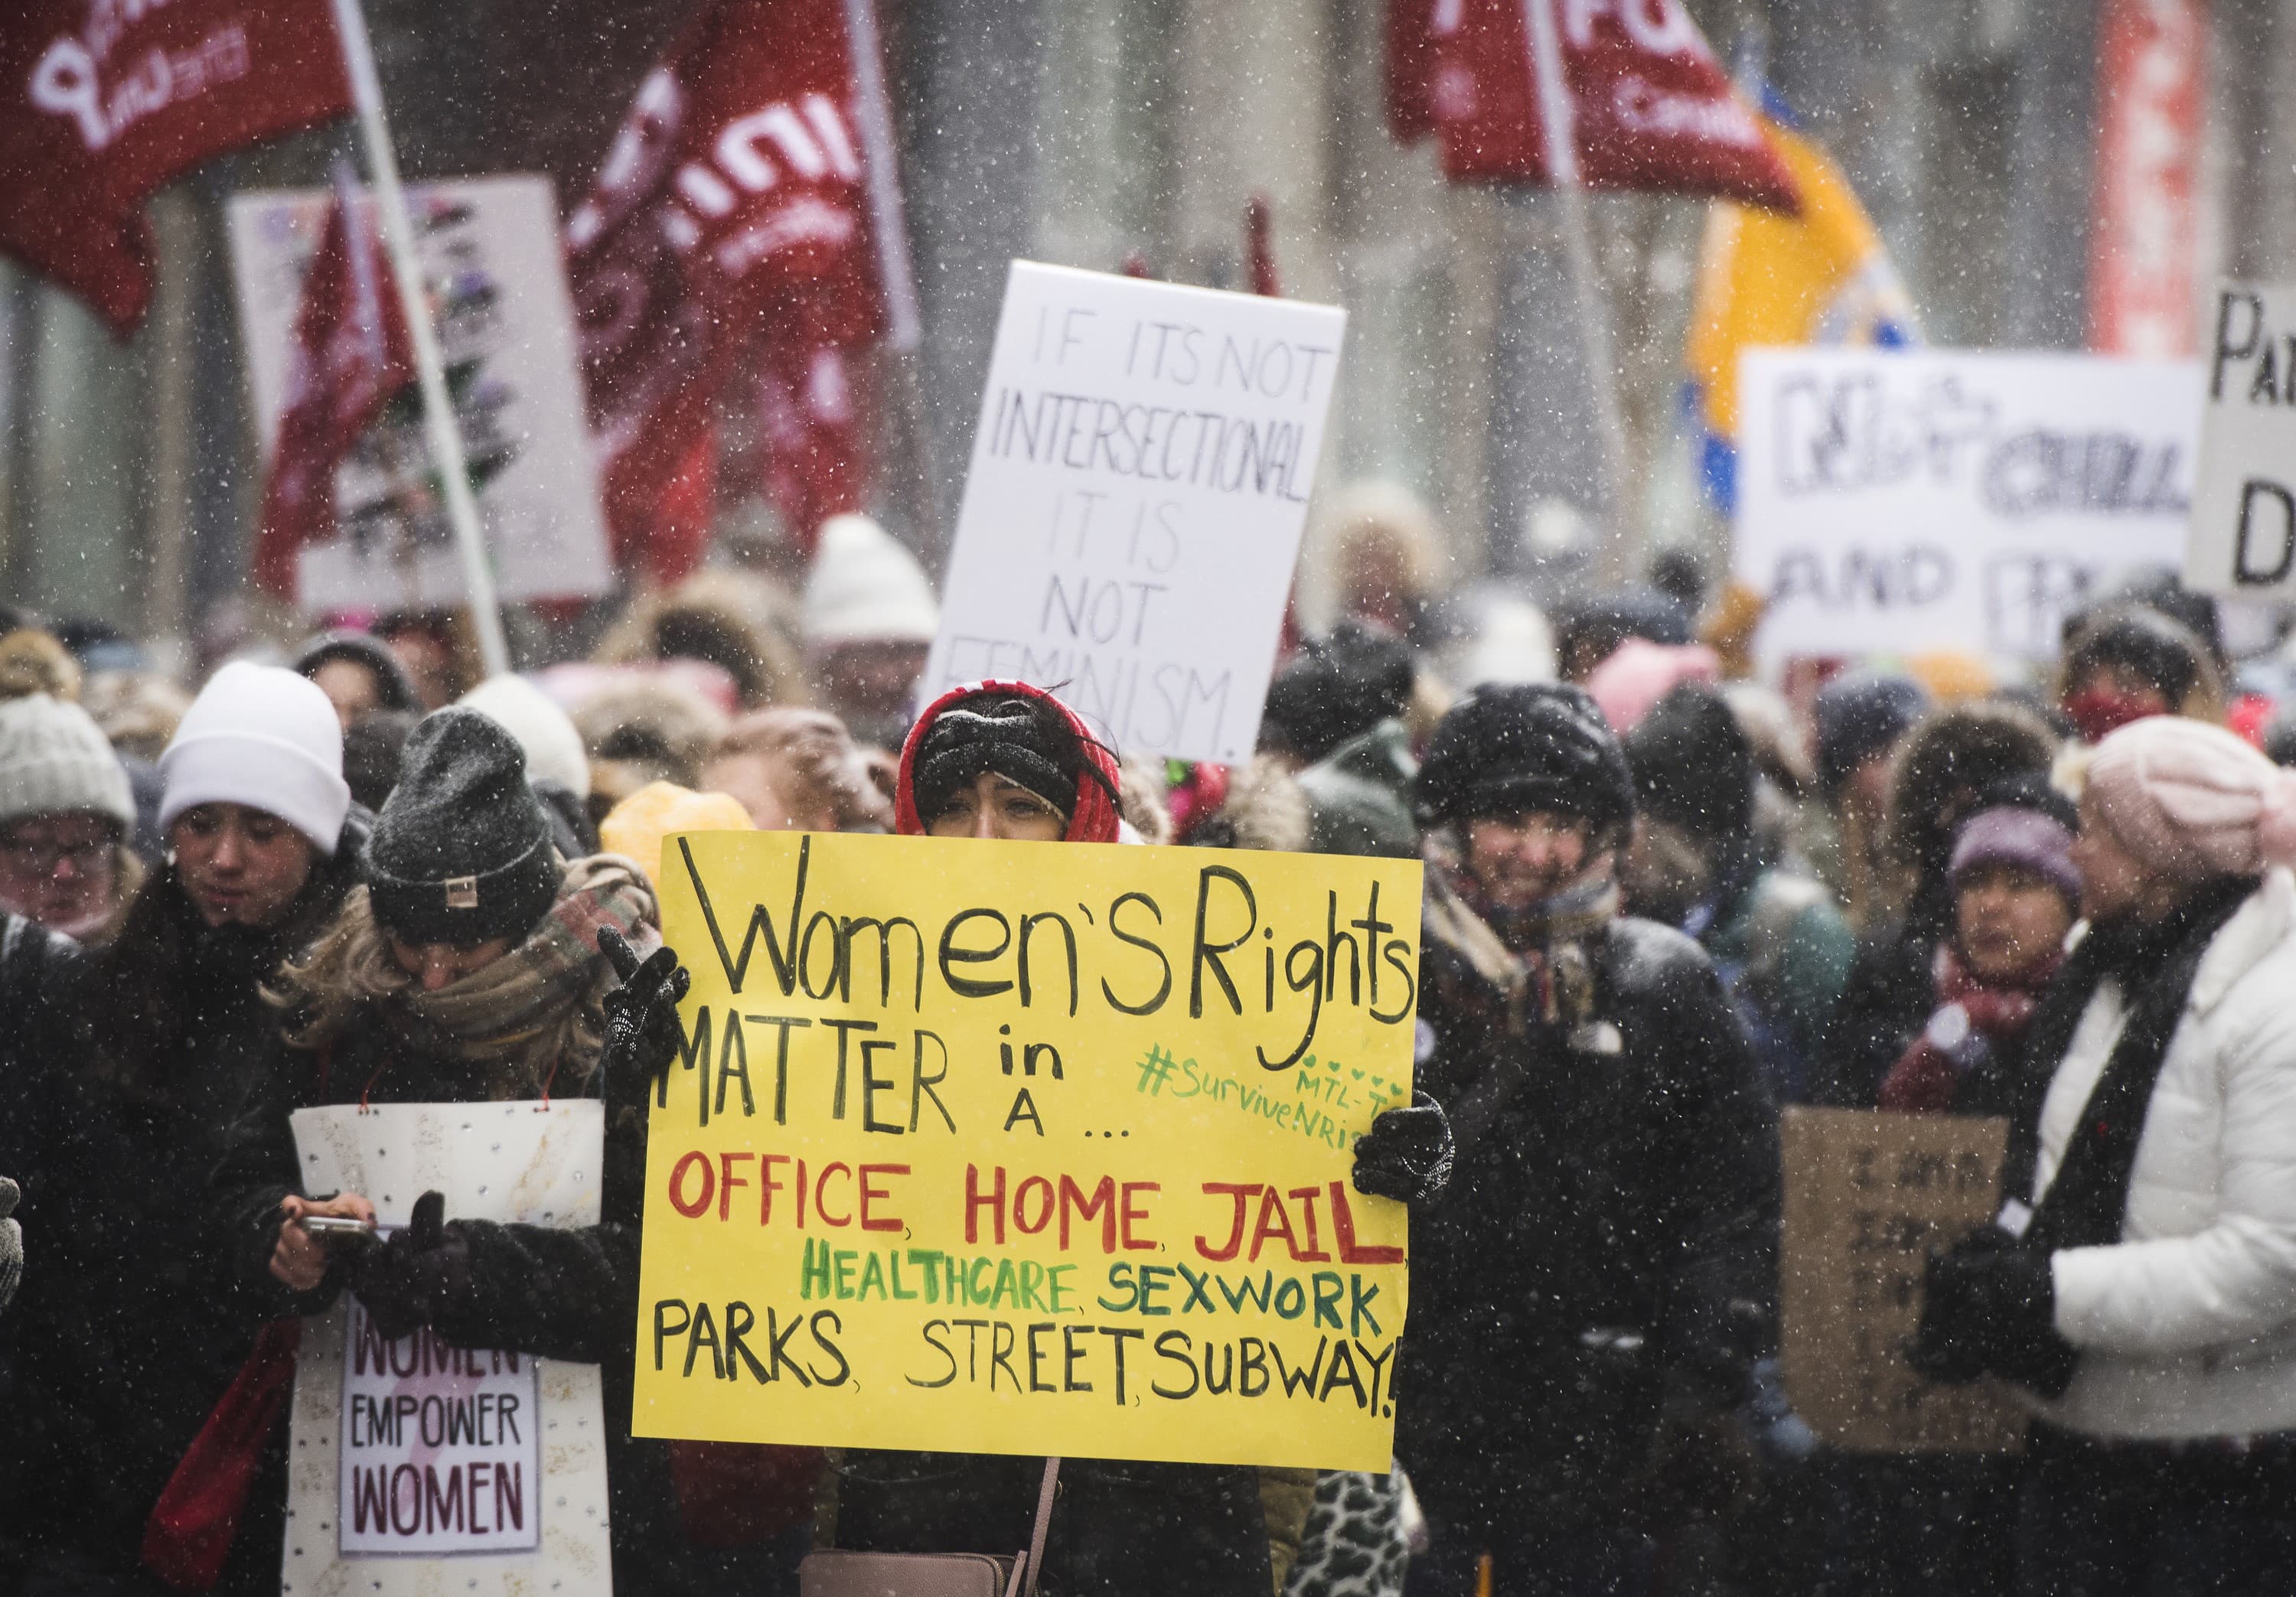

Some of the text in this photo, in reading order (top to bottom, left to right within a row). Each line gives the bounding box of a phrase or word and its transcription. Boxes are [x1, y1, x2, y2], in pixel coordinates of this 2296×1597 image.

[1031, 304, 1333, 405] IF ITS NOT
[990, 386, 1309, 504] INTERSECTIONAL
[1046, 488, 1184, 575] IT IS
[1039, 572, 1169, 648] NOT
[1189, 864, 1415, 1072] Rights
[657, 1004, 1064, 1135] MATTER in
[1003, 1087, 1045, 1137] A
[1296, 1069, 1402, 1119] MTL-T
[668, 1150, 1409, 1271] OFFICE, HOME, JAIL,
[800, 1236, 1383, 1338] HEALTHCARE, SEXWORK
[654, 1298, 861, 1394] PARKS,
[350, 1393, 522, 1448] EMPOWER
[352, 1461, 524, 1536] WOMEN
